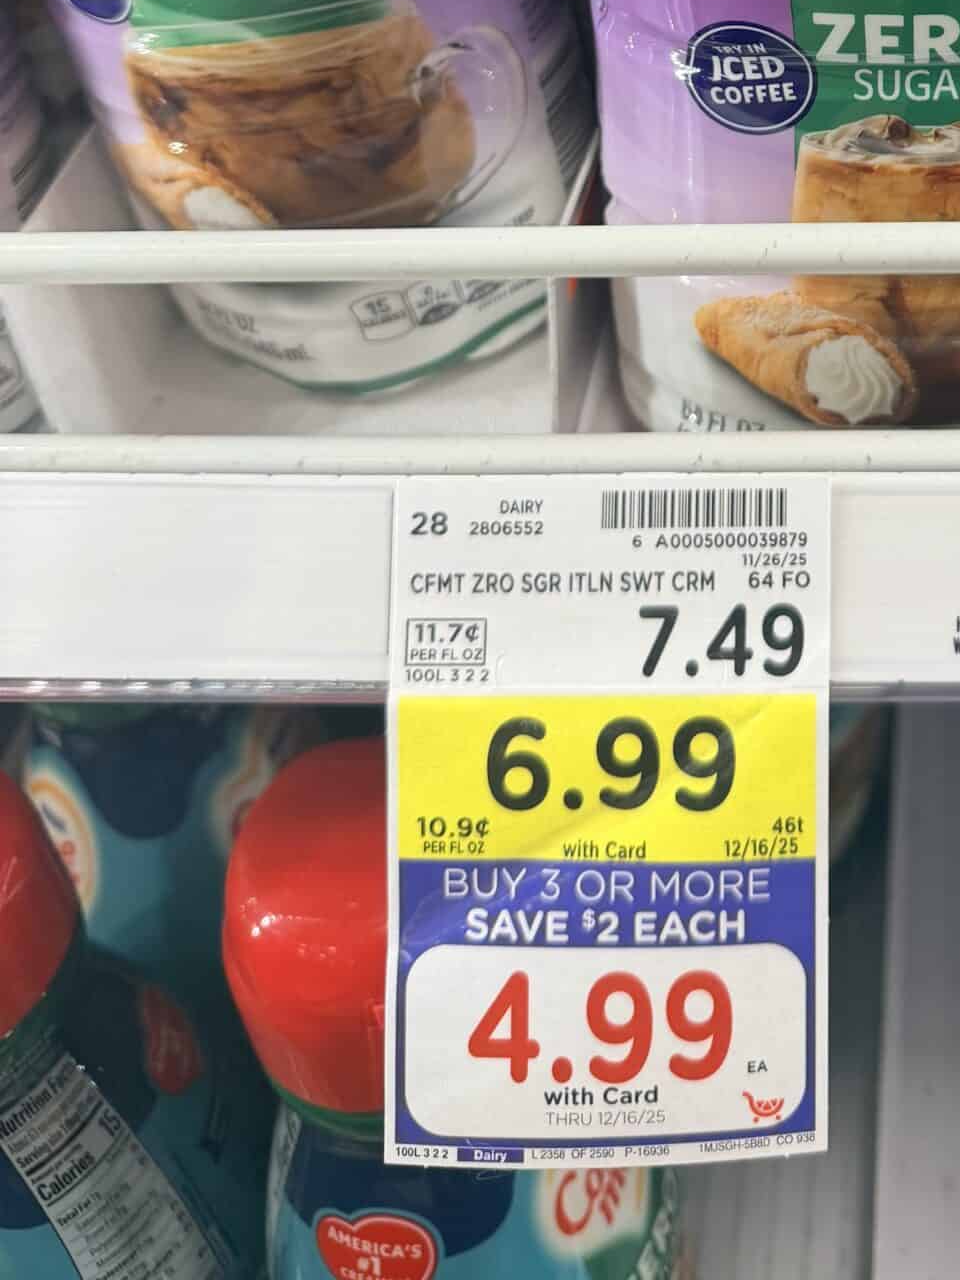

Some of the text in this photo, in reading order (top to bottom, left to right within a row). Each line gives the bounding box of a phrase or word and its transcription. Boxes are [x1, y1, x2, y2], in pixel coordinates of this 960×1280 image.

[712, 42, 768, 56] TRY IN
[711, 55, 785, 83] ICED
[710, 82, 798, 106] COFFEE
[499, 499, 544, 515] DAIRY
[410, 512, 544, 537] 28 2806552
[632, 532, 808, 549] 6 A0005000039879
[742, 553, 807, 568] 11/26/25
[410, 570, 811, 595] CFMT ZRO SGR ITLN SWT CRM 64 FO
[414, 623, 480, 645] 11.7¢
[639, 602, 805, 678] 7.49
[410, 646, 484, 662] PER FL OZ
[405, 669, 490, 683] 100L 3 2 2
[487, 716, 736, 812] 6.99
[417, 816, 490, 839] 10.9¢
[772, 816, 804, 835] 46t
[423, 839, 485, 855] PER FL OZ
[563, 839, 646, 860] with Card
[724, 838, 799, 861] 12/16/25
[443, 867, 771, 902] BUY 3 OR MORE
[465, 907, 745, 943] SAVE $2 EACH
[467, 969, 734, 1085] 4.99
[747, 1060, 768, 1074] EA
[544, 1085, 659, 1106] with Card
[545, 1109, 667, 1128] THRU 12/16/25
[776, 1133, 794, 1146] CO
[395, 1146, 449, 1159] 100L 3 2 2
[473, 1149, 507, 1162] Dairy
[571, 1148, 586, 1160] OF
[36, 1150, 97, 1202] Calories
[327, 1224, 423, 1260] AMERICA'S
[357, 1255, 382, 1277] #1
